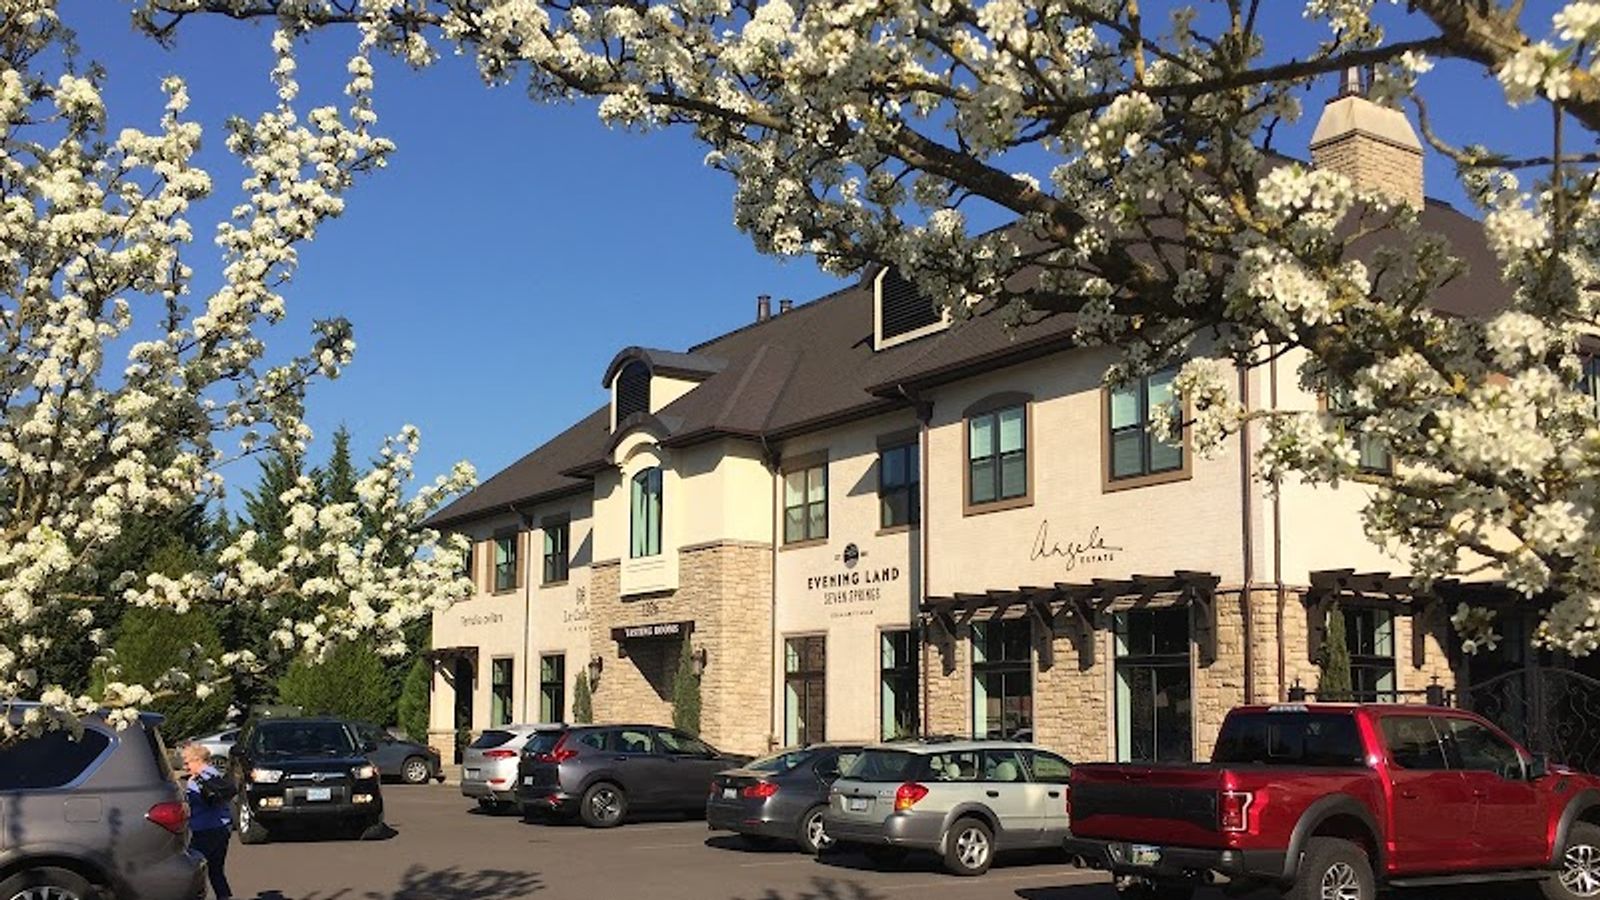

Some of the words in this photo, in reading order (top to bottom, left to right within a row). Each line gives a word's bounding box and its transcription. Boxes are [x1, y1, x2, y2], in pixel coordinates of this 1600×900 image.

[1080, 553, 1114, 563] ESTATE
[807, 571, 860, 590] EVENING
[865, 566, 900, 583] LAND
[823, 591, 847, 605] SEVEN
[848, 587, 881, 603] SPRINGS
[625, 627, 653, 638] TASTING
[653, 624, 679, 636] ROOMS
